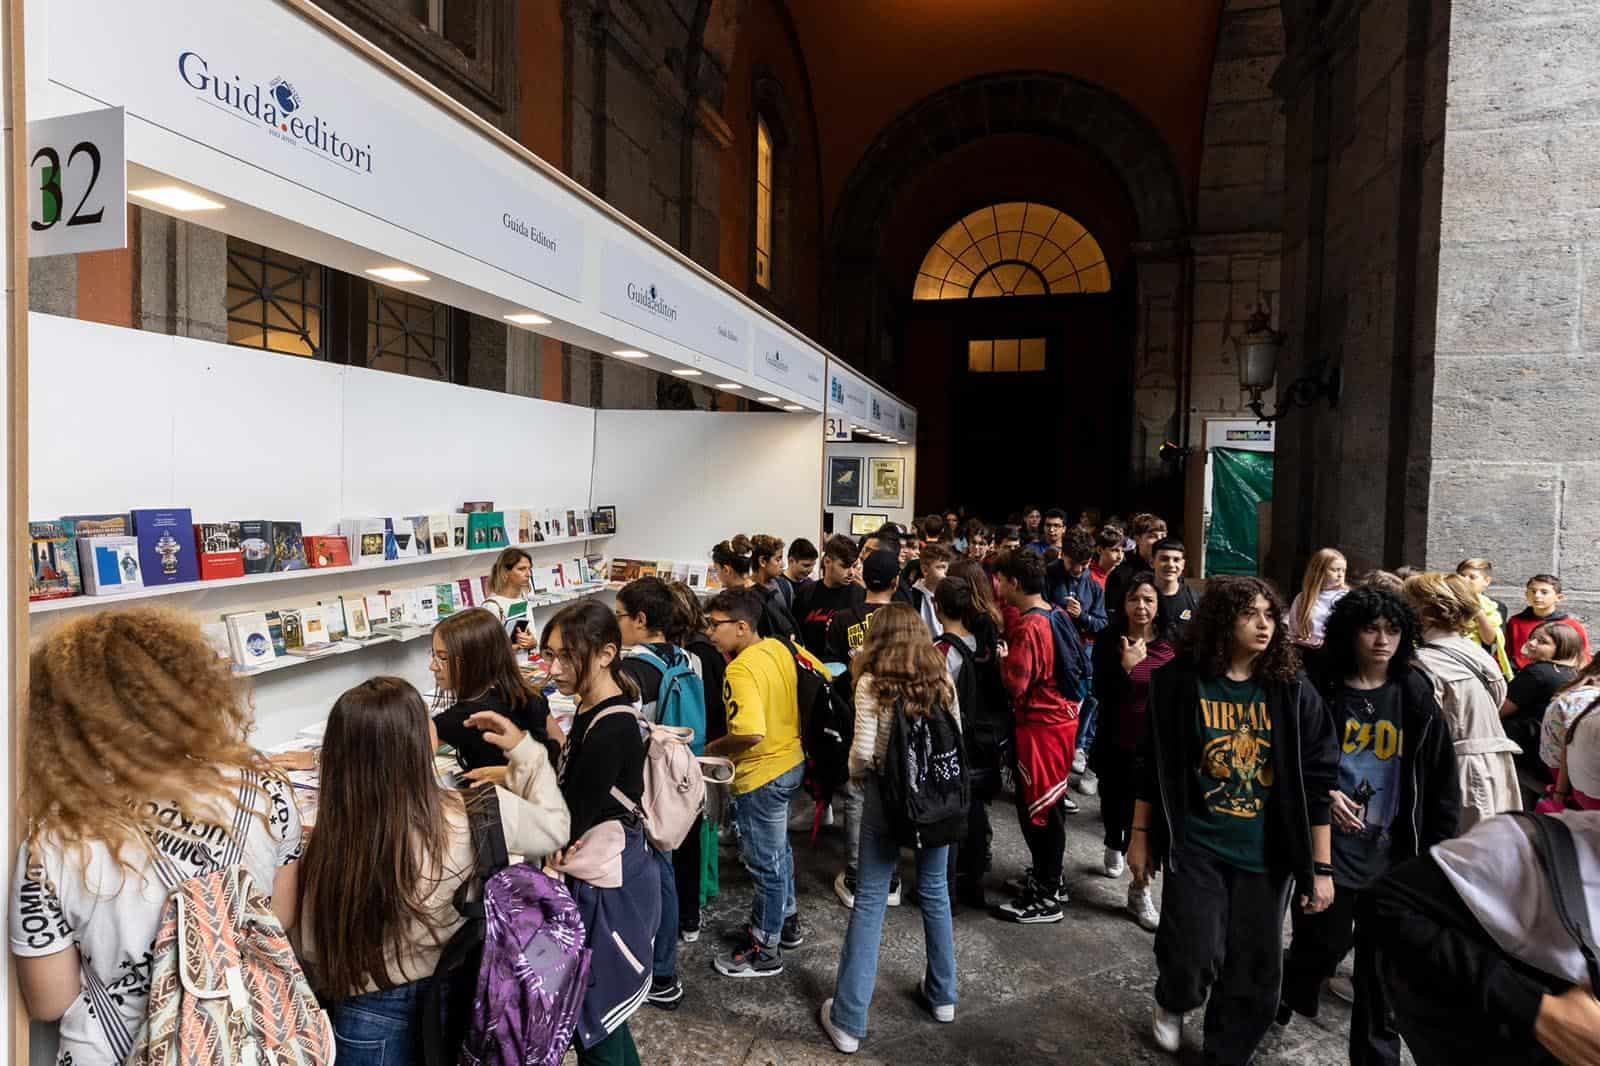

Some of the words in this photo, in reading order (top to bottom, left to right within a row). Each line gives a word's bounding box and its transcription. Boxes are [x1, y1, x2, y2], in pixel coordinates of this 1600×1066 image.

[30, 141, 105, 231] 32
[503, 212, 529, 238] Guida
[530, 226, 557, 252] Editori
[825, 418, 848, 437] 31
[1200, 698, 1272, 731] NIRVAN
